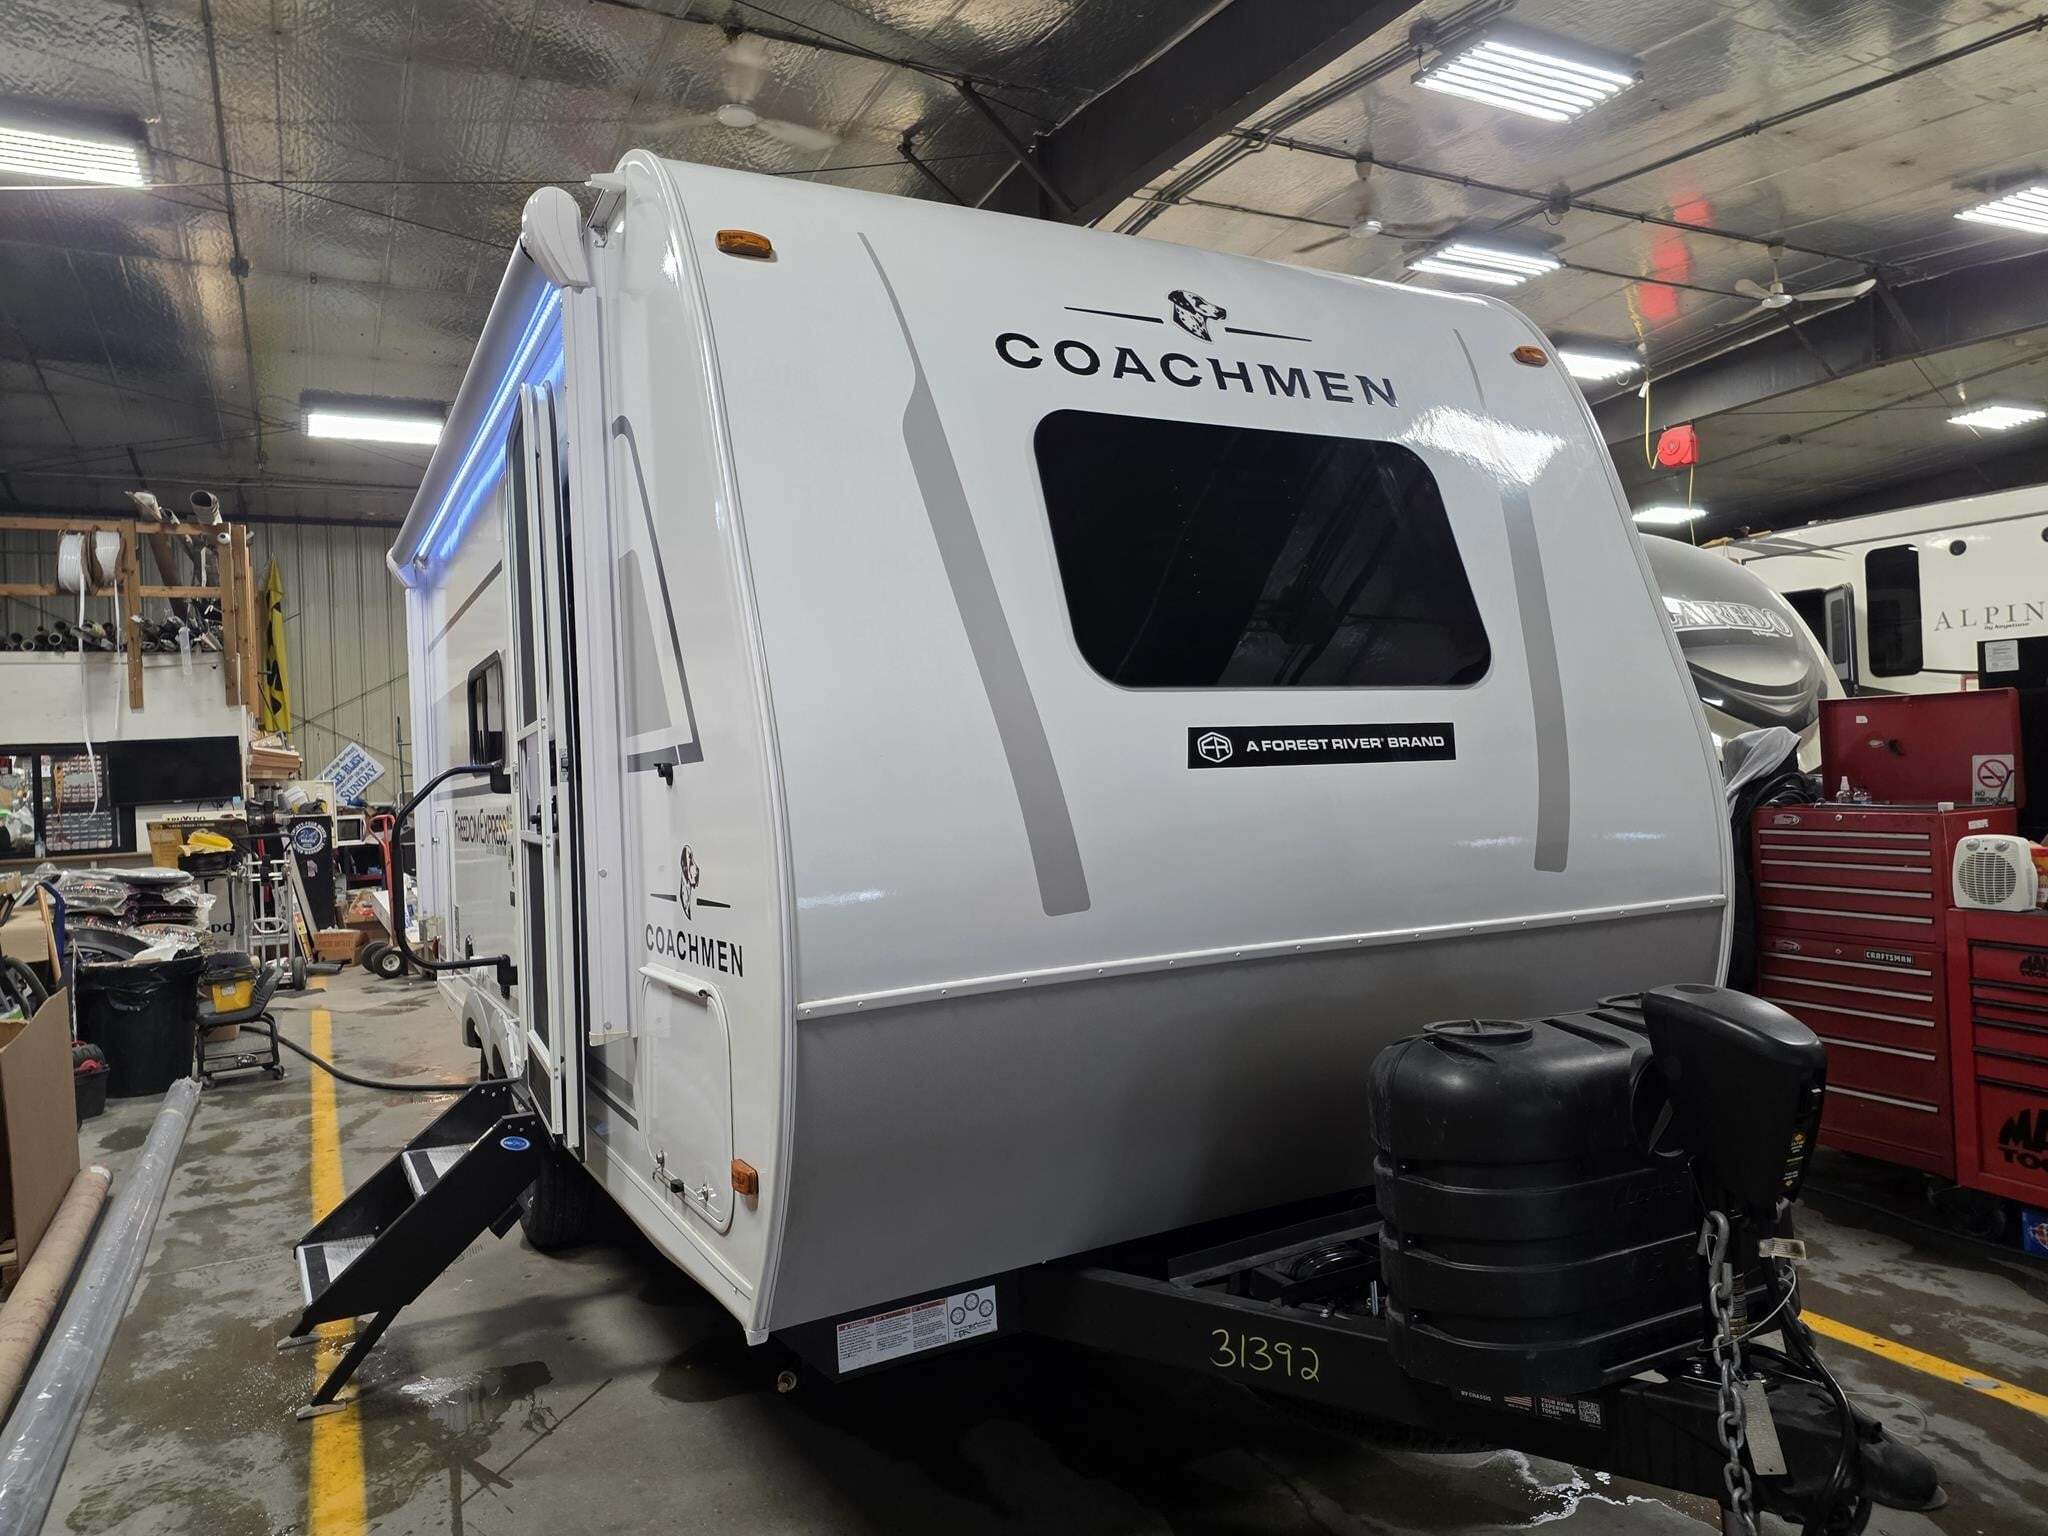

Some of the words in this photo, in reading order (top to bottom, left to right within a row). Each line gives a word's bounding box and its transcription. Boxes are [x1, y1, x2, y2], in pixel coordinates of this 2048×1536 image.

[994, 331, 1399, 408] COACHMEN
[1246, 740, 1260, 753] A
[1261, 738, 1329, 752] FOREST
[1387, 735, 1446, 749] BRAND
[645, 923, 744, 978] COACHMEN
[1866, 951, 1913, 964] CRAFTSMAN
[1209, 1329, 1320, 1383] 31392
[1541, 1403, 1576, 1415] EXPERIENCE
